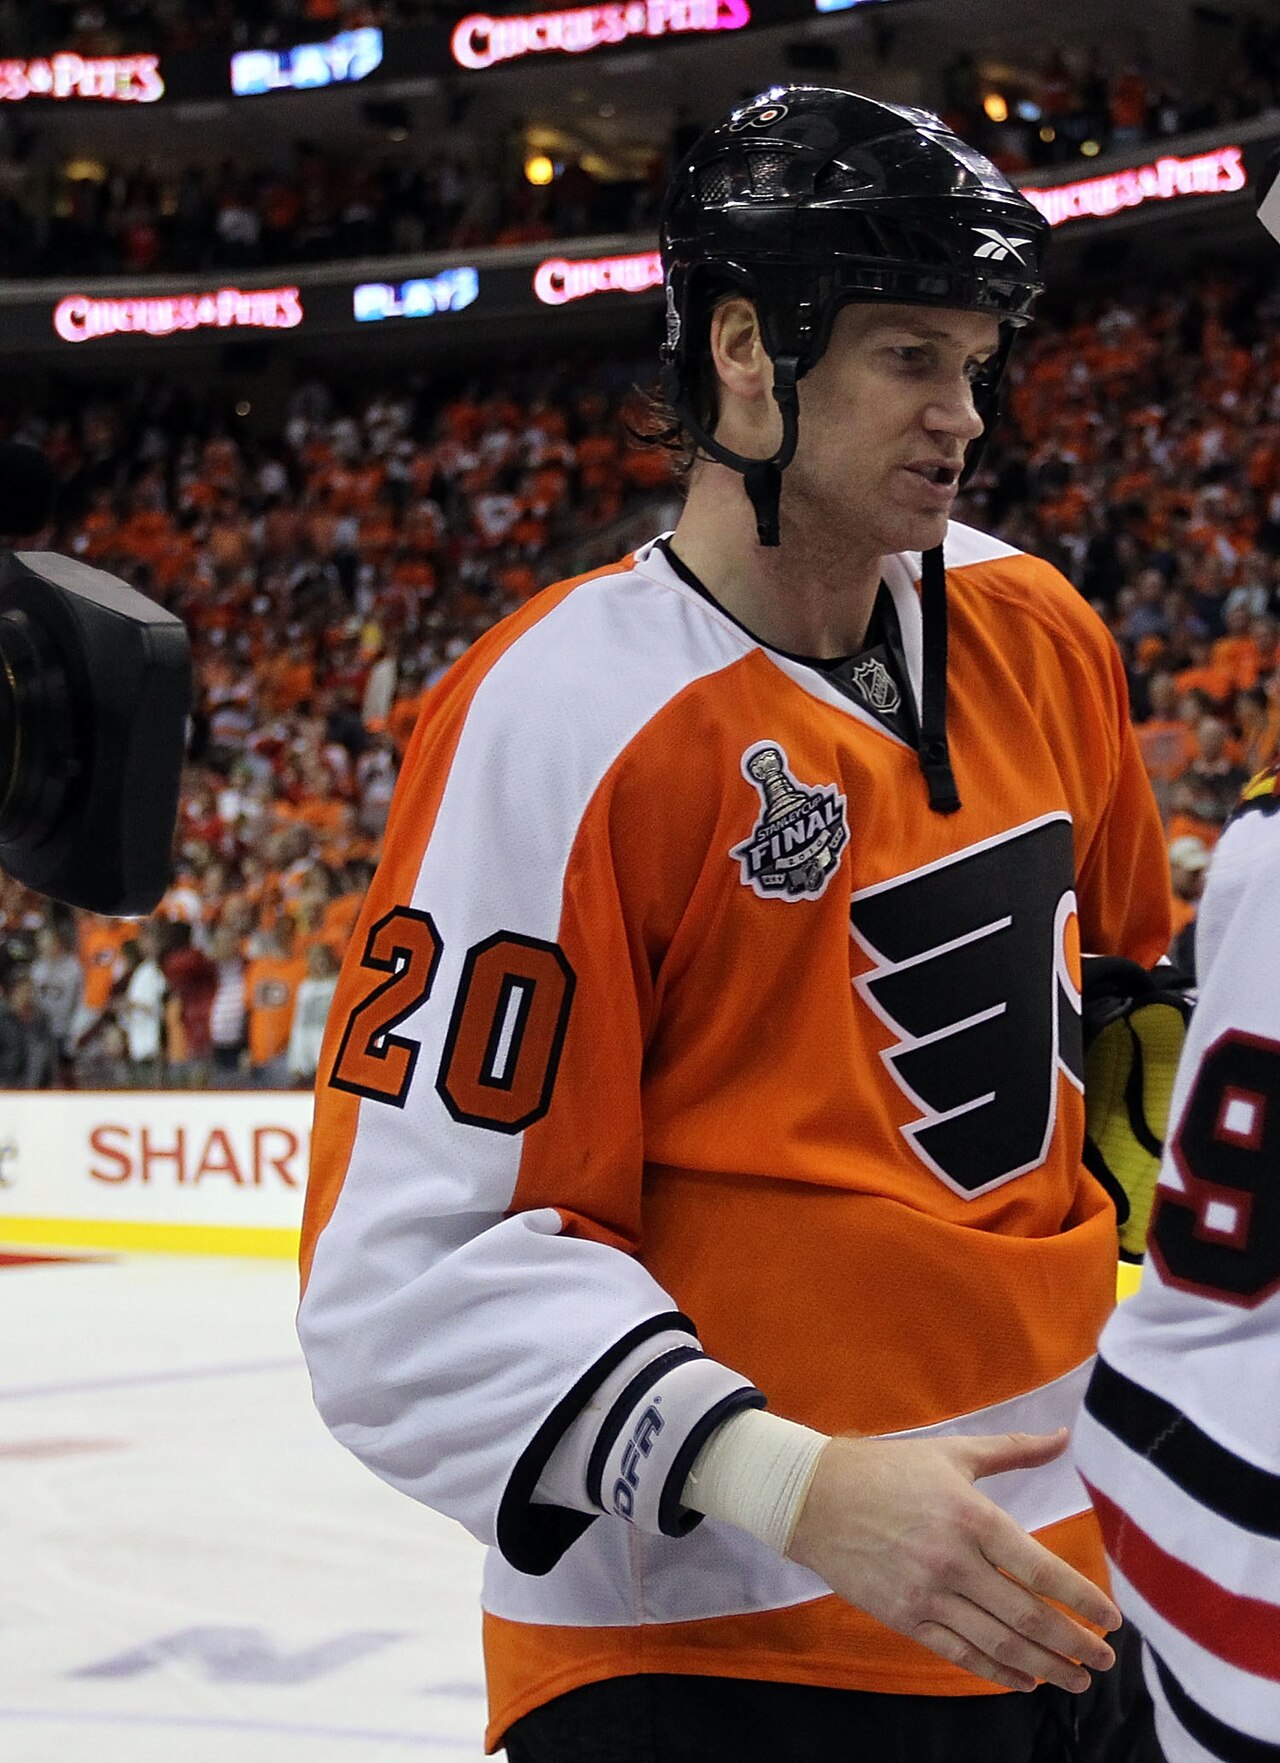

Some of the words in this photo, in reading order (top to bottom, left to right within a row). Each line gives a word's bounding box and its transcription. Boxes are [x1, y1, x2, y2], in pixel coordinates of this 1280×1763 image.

[749, 801, 841, 871] FINAL
[757, 811, 801, 842] STANLEY
[800, 795, 824, 820] CUP
[788, 838, 823, 866] 2010
[328, 904, 577, 1136] 20
[88, 1123, 313, 1188] SHAR
